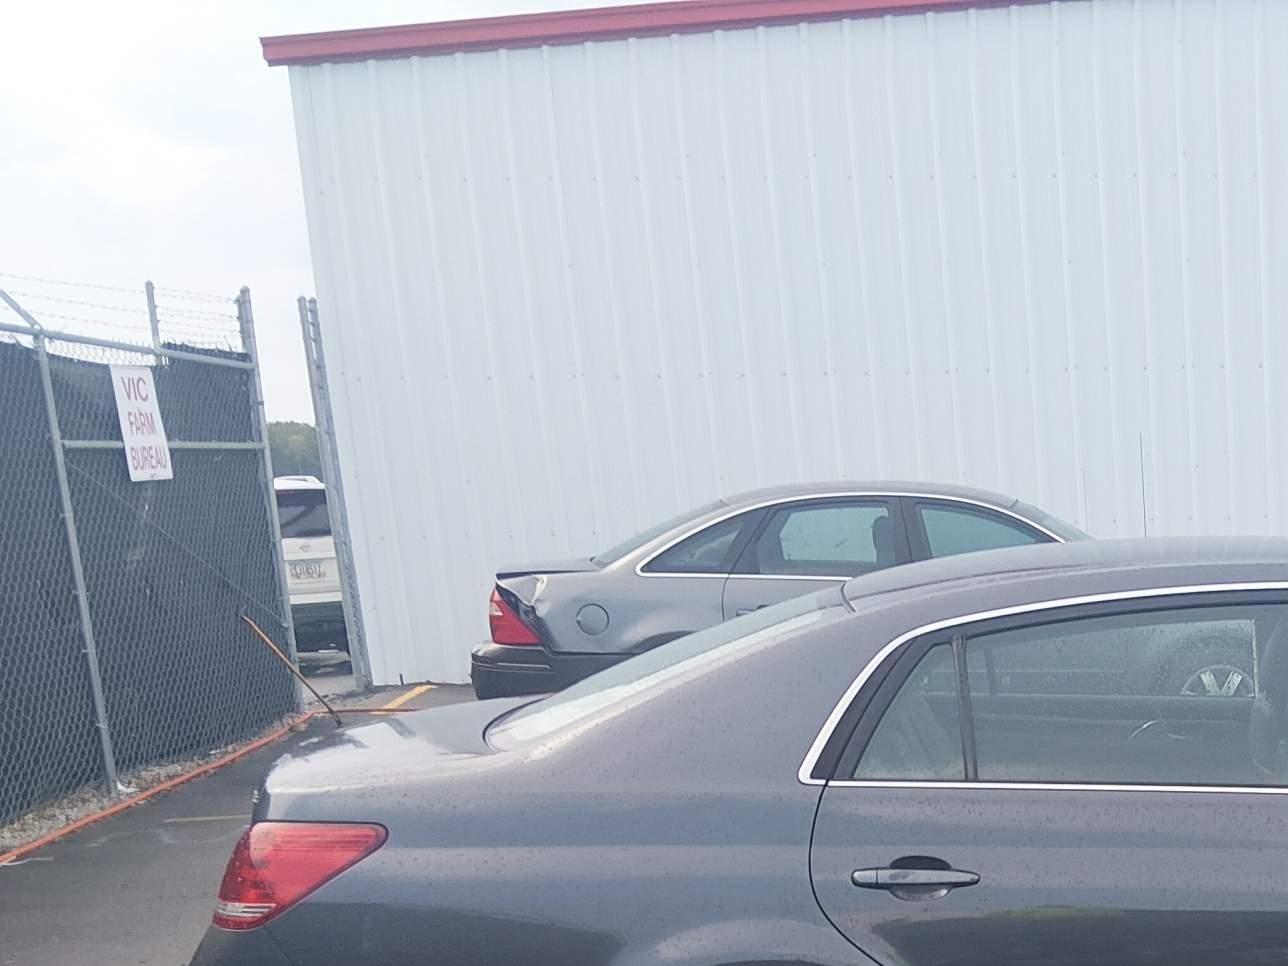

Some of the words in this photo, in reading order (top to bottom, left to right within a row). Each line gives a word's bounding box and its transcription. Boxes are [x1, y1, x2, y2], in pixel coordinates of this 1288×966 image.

[120, 376, 149, 402] VIC
[128, 411, 157, 436] FARM
[130, 446, 168, 471] BUREAU
